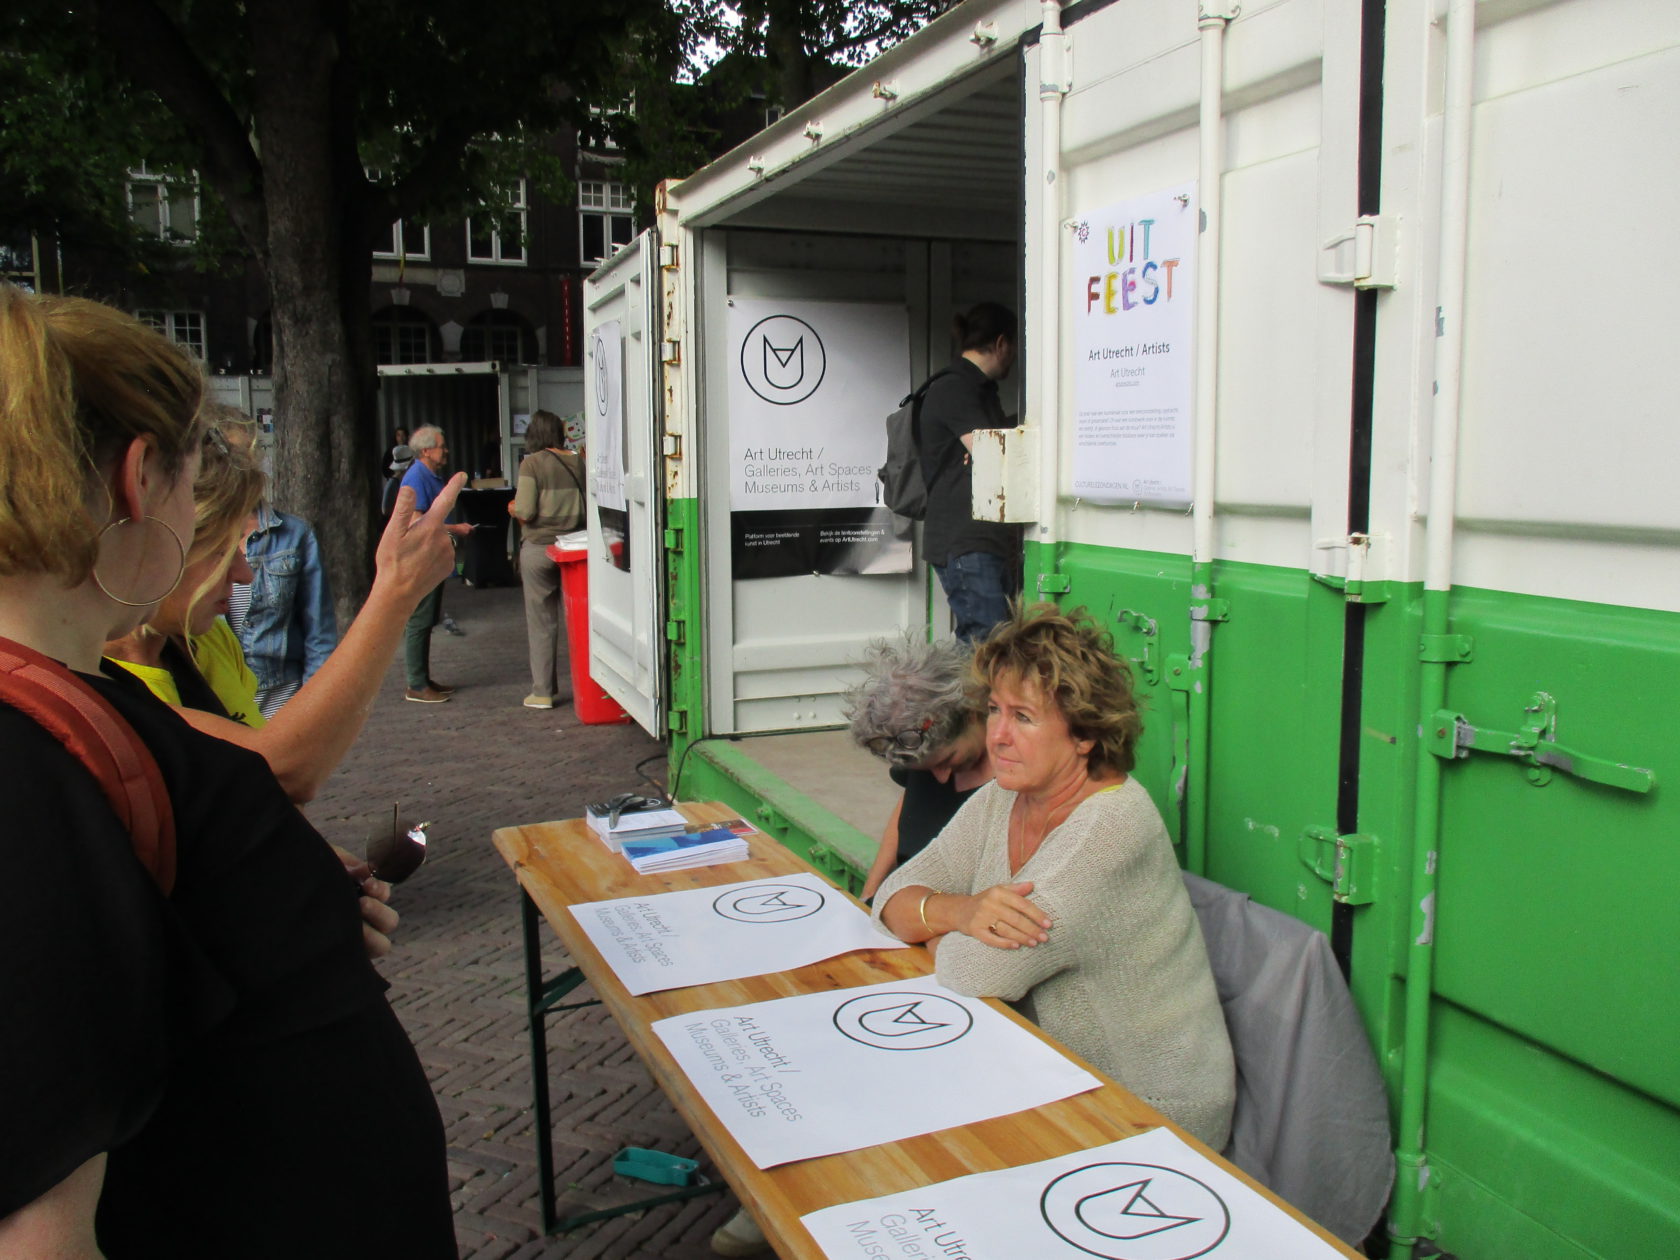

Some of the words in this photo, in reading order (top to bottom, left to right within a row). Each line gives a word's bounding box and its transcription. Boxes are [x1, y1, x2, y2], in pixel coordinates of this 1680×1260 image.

[1107, 218, 1156, 266] UIT
[1087, 257, 1180, 316] FEEST
[1088, 349, 1100, 361] Art
[1102, 346, 1134, 359] Utrecht
[1142, 341, 1170, 356] Artists
[1110, 368, 1119, 378] Art
[1120, 366, 1145, 378] Utrecht
[744, 448, 764, 460] Art
[768, 447, 813, 460] Utrecht
[817, 447, 824, 460] /
[744, 464, 801, 478] Galleries,
[805, 463, 824, 476] Art
[828, 463, 872, 478] Spaces
[744, 481, 804, 493] Museums
[808, 479, 818, 492] &
[822, 479, 860, 492] Artists
[684, 1022, 729, 1072] Museums
[733, 1016, 760, 1031] Art
[748, 1031, 792, 1068] Utrecht
[710, 1019, 751, 1065] Galleries,
[743, 1066, 773, 1082] Art
[759, 1082, 803, 1122] Spaces
[720, 1073, 743, 1083] &
[727, 1085, 766, 1118] Artists
[908, 1208, 947, 1232] Art
